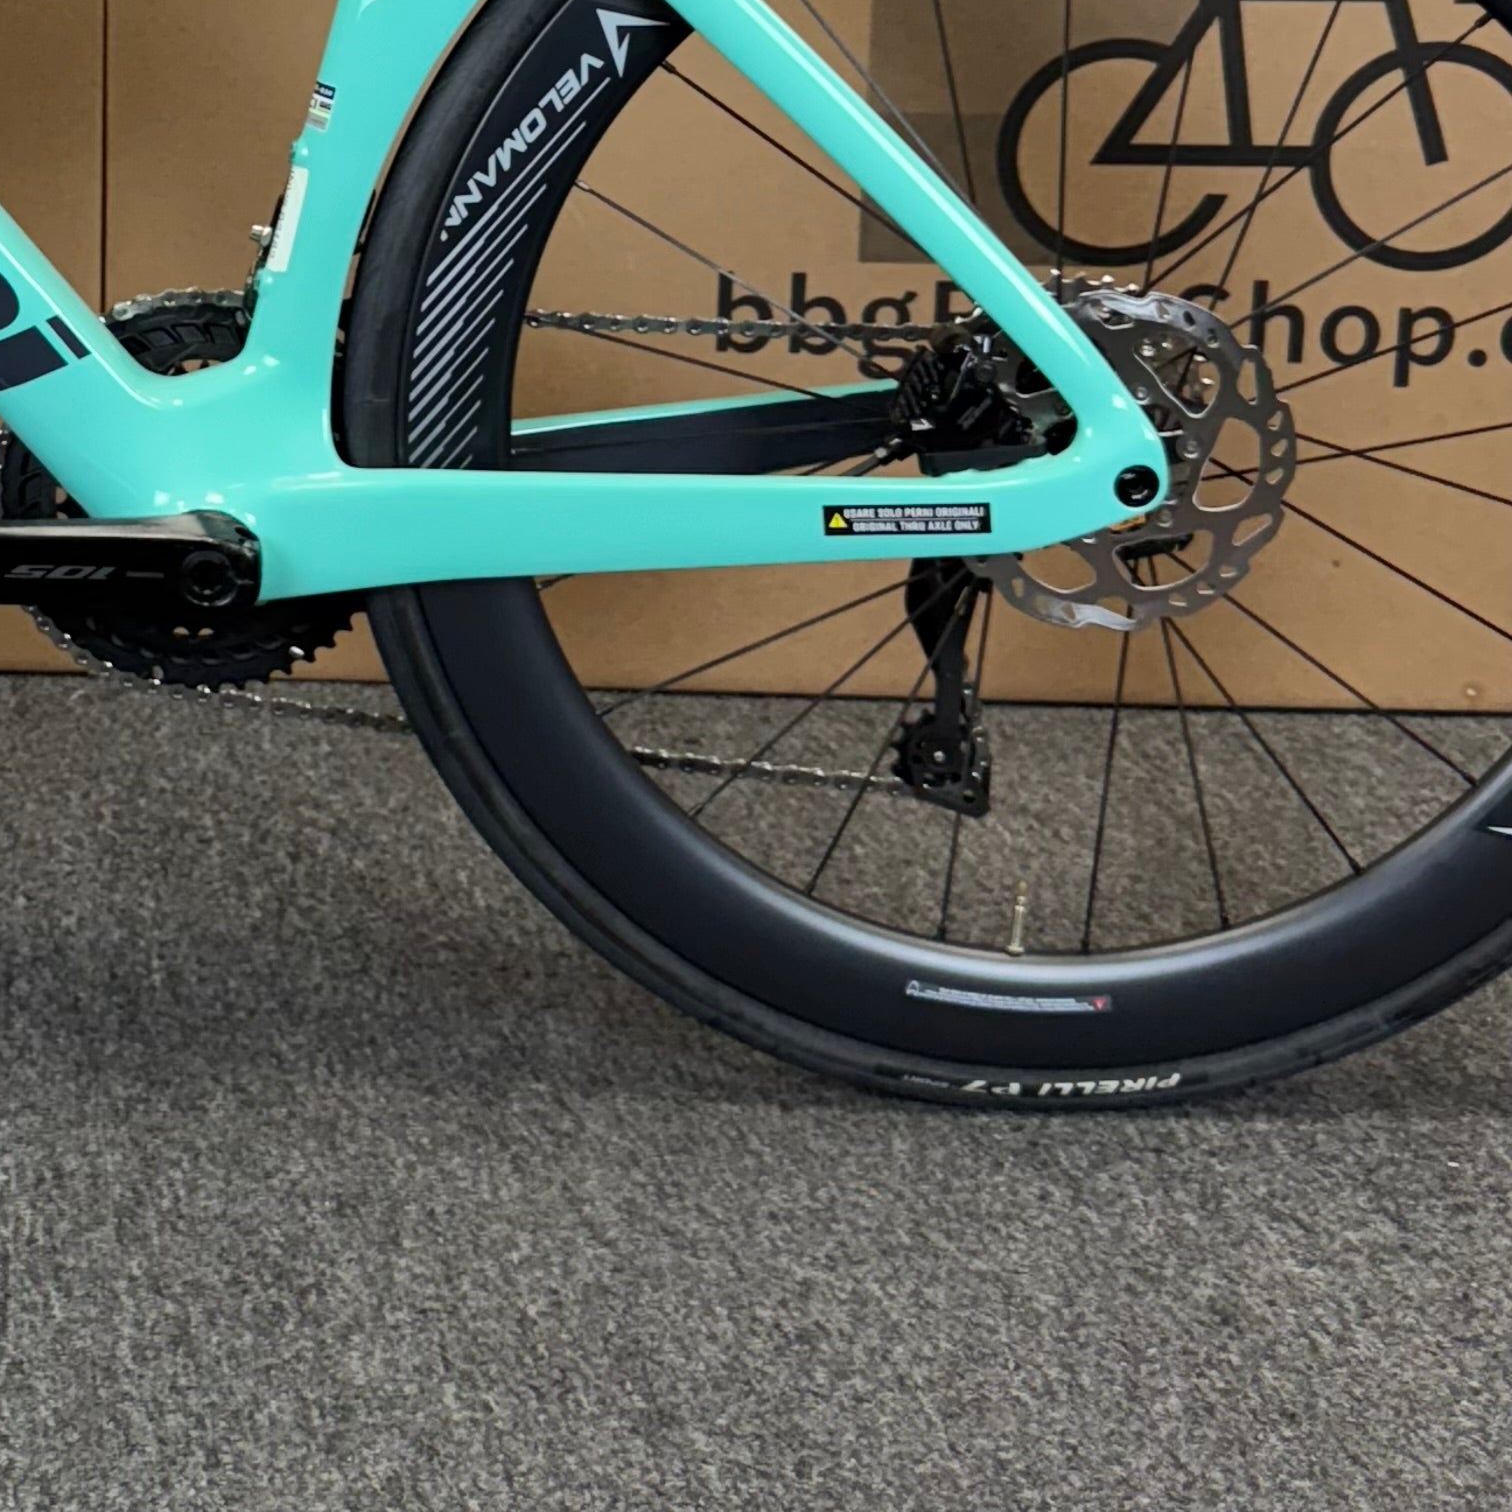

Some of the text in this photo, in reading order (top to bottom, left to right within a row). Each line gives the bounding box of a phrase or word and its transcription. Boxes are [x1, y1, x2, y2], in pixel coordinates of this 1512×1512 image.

[4, 565, 118, 580] 105
[961, 1080, 1020, 1095] P7
[1037, 1072, 1181, 1096] PIRELLI
